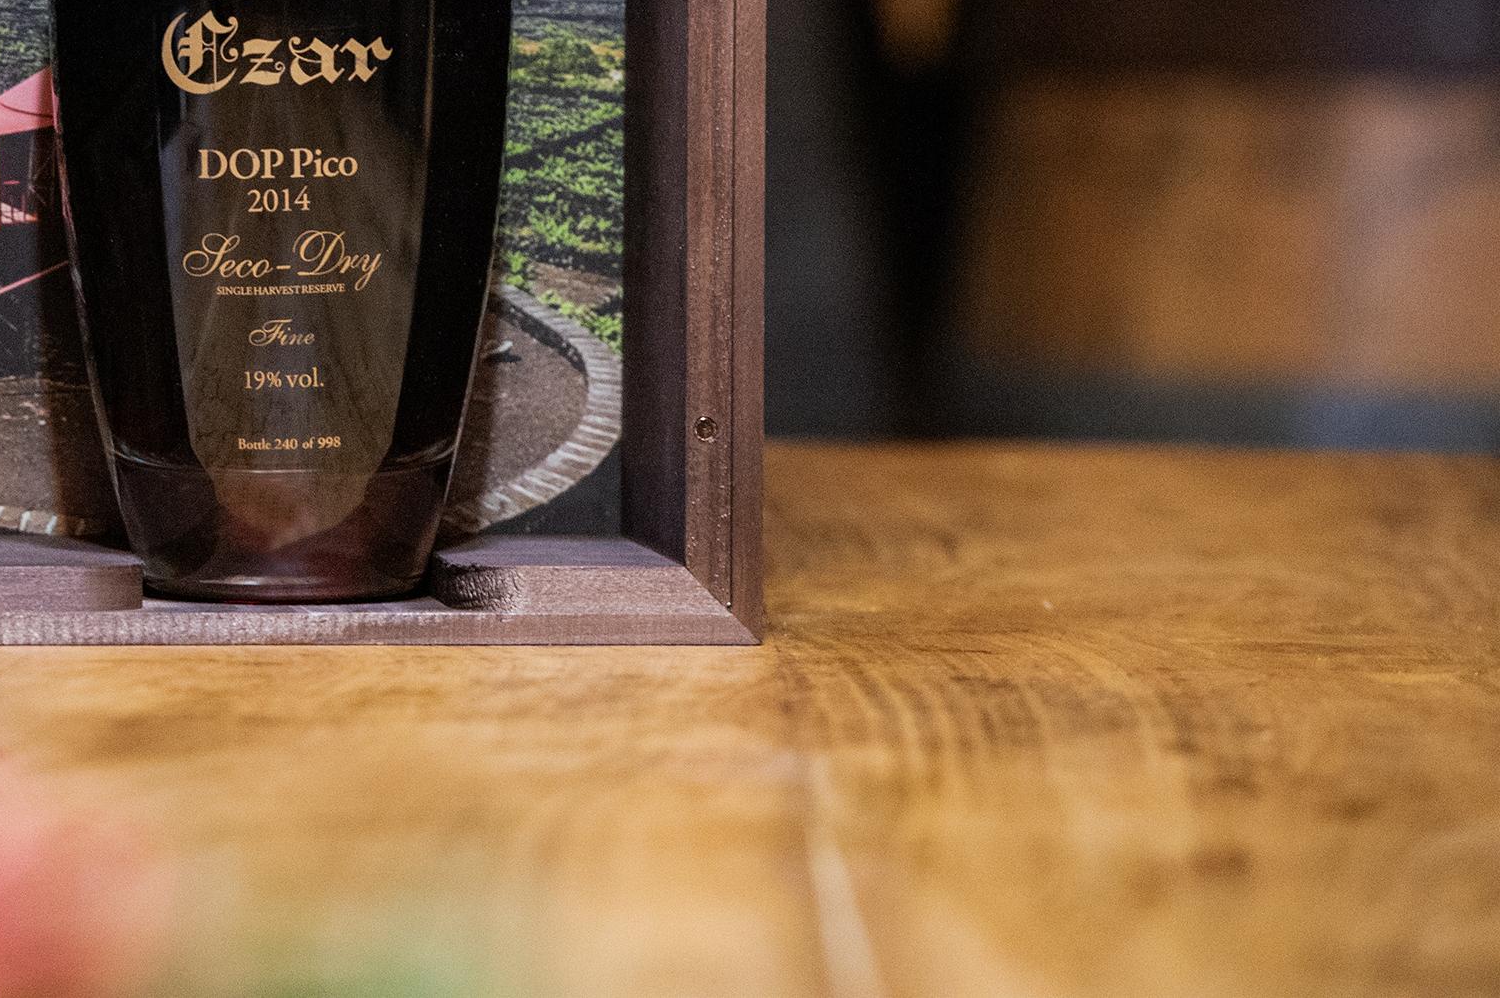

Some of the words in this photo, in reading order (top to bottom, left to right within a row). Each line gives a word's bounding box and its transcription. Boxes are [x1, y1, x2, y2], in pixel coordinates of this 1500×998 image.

[161, 9, 393, 95] Czar
[199, 148, 284, 180] DOP
[291, 147, 359, 179] Pico
[248, 188, 311, 213] 2014
[216, 286, 253, 296] SINGLE
[254, 285, 300, 296] HARVEST
[301, 283, 345, 294] RESERVE
[248, 318, 315, 347] Fine
[244, 370, 282, 391] 19%
[286, 366, 324, 388] vol.
[238, 438, 271, 450] Bottle
[274, 438, 298, 450] 240
[302, 436, 314, 449] of
[317, 436, 341, 448] 998
